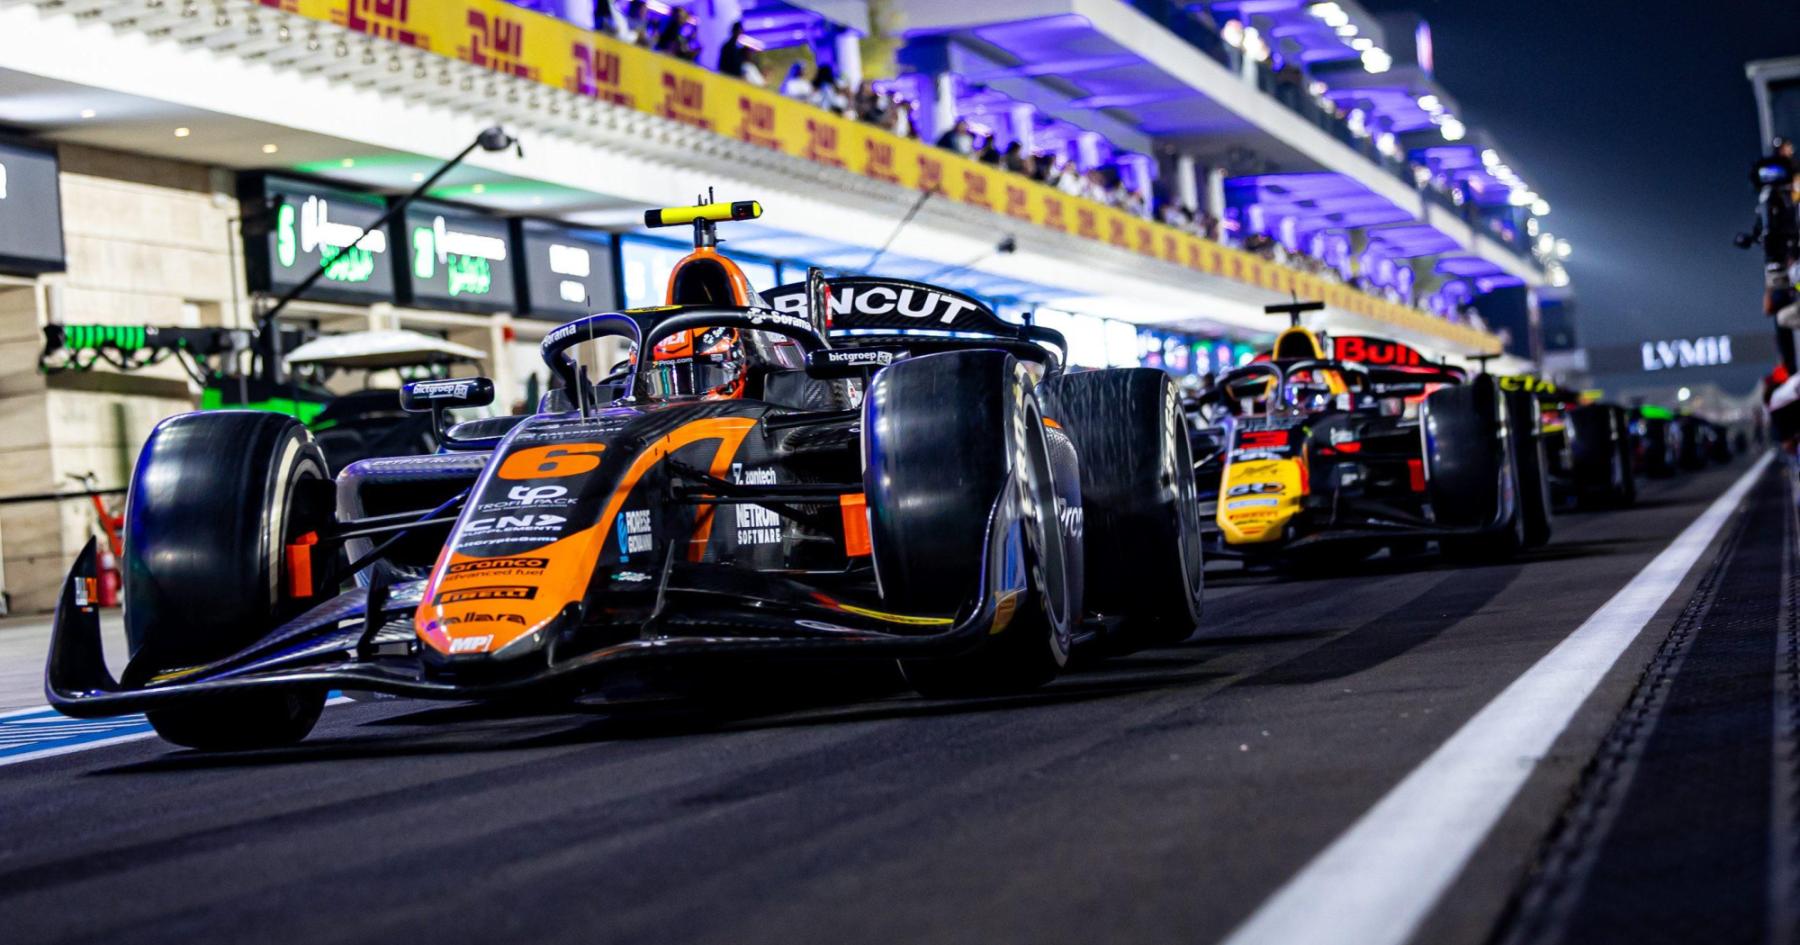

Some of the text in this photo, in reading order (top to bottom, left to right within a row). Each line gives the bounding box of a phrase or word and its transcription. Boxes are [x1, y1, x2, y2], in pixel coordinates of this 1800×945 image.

[774, 286, 976, 324] RNCUT
[1335, 336, 1420, 366] Bull
[497, 443, 606, 480] 6
[737, 527, 782, 545] SOFTWARE
[450, 559, 542, 572] aramco
[515, 568, 544, 577] fuel
